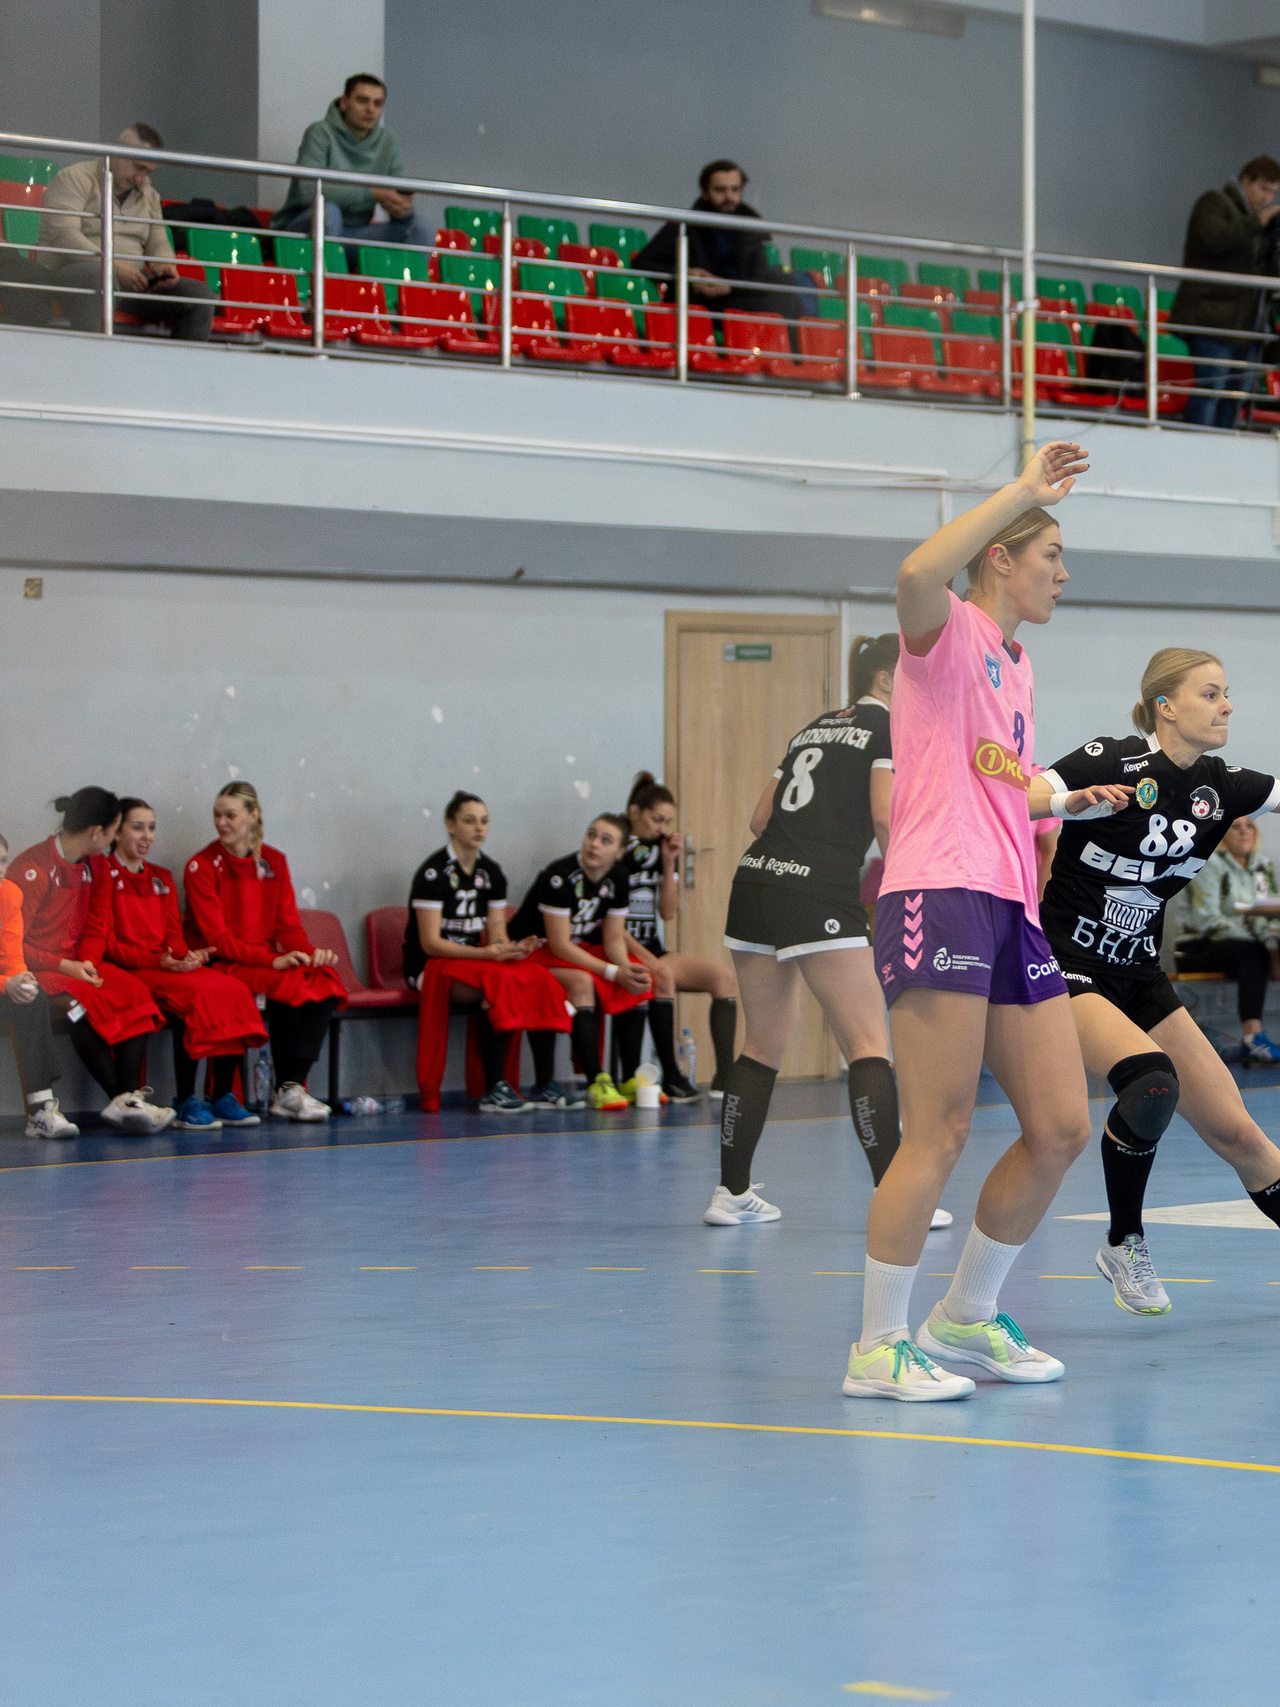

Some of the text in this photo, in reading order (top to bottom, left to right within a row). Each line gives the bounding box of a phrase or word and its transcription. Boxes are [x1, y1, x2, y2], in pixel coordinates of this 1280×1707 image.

[781, 747, 823, 812] 8
[1139, 813, 1197, 858] 88
[738, 854, 811, 877] insk Region
[721, 1093, 742, 1148] Kempa
[855, 1095, 879, 1149] Kempa
